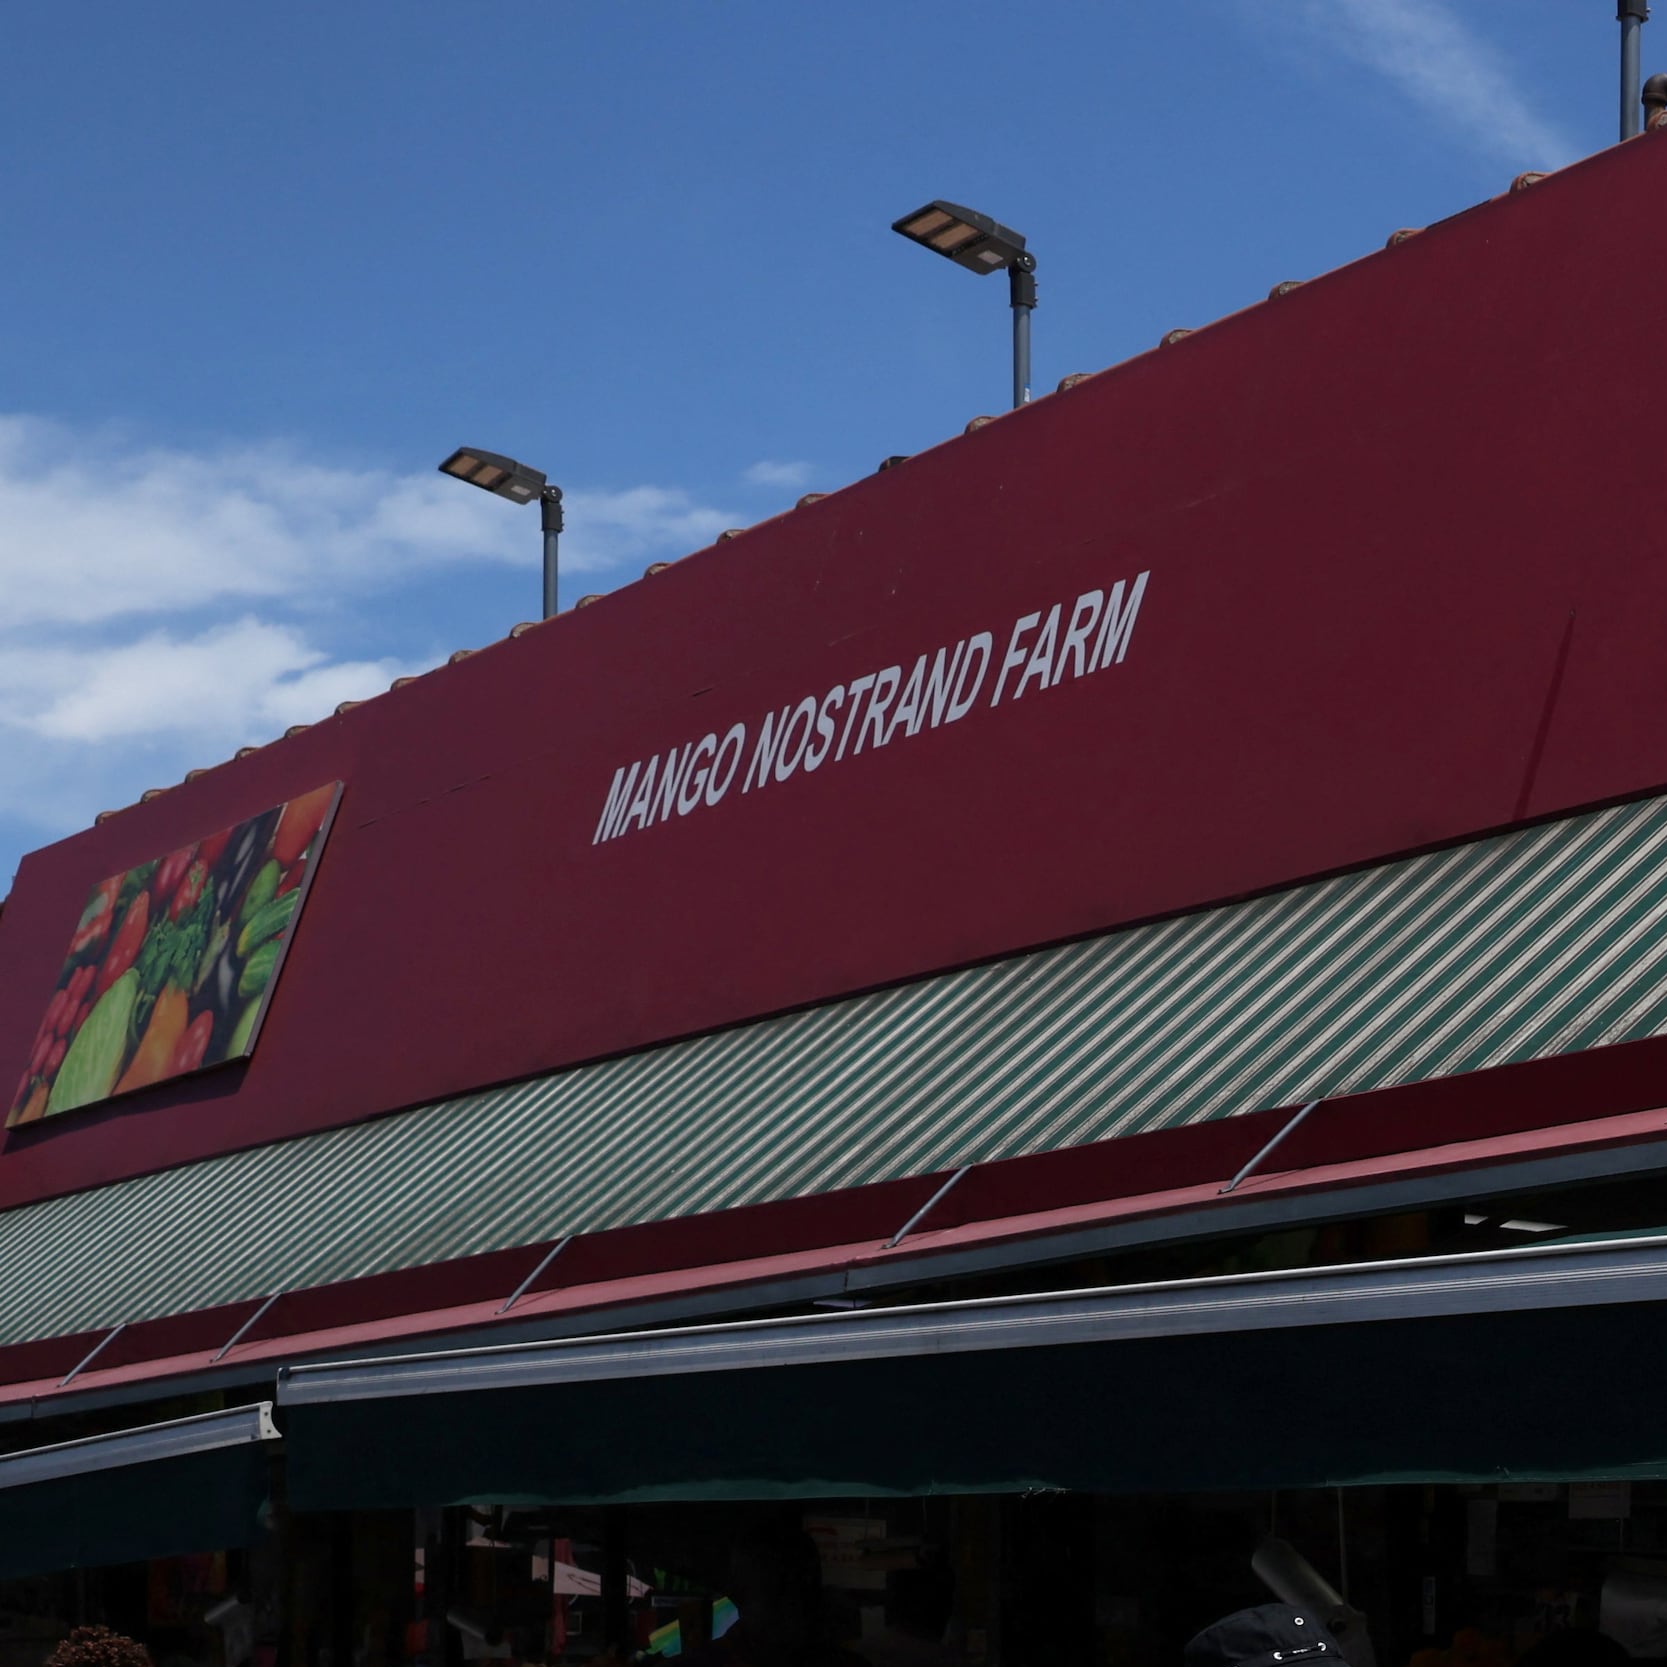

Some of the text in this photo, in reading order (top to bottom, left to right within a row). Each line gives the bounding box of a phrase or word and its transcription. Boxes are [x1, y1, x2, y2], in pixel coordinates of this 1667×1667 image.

[592, 570, 1151, 846] MANGO NOSTRAND FARM
